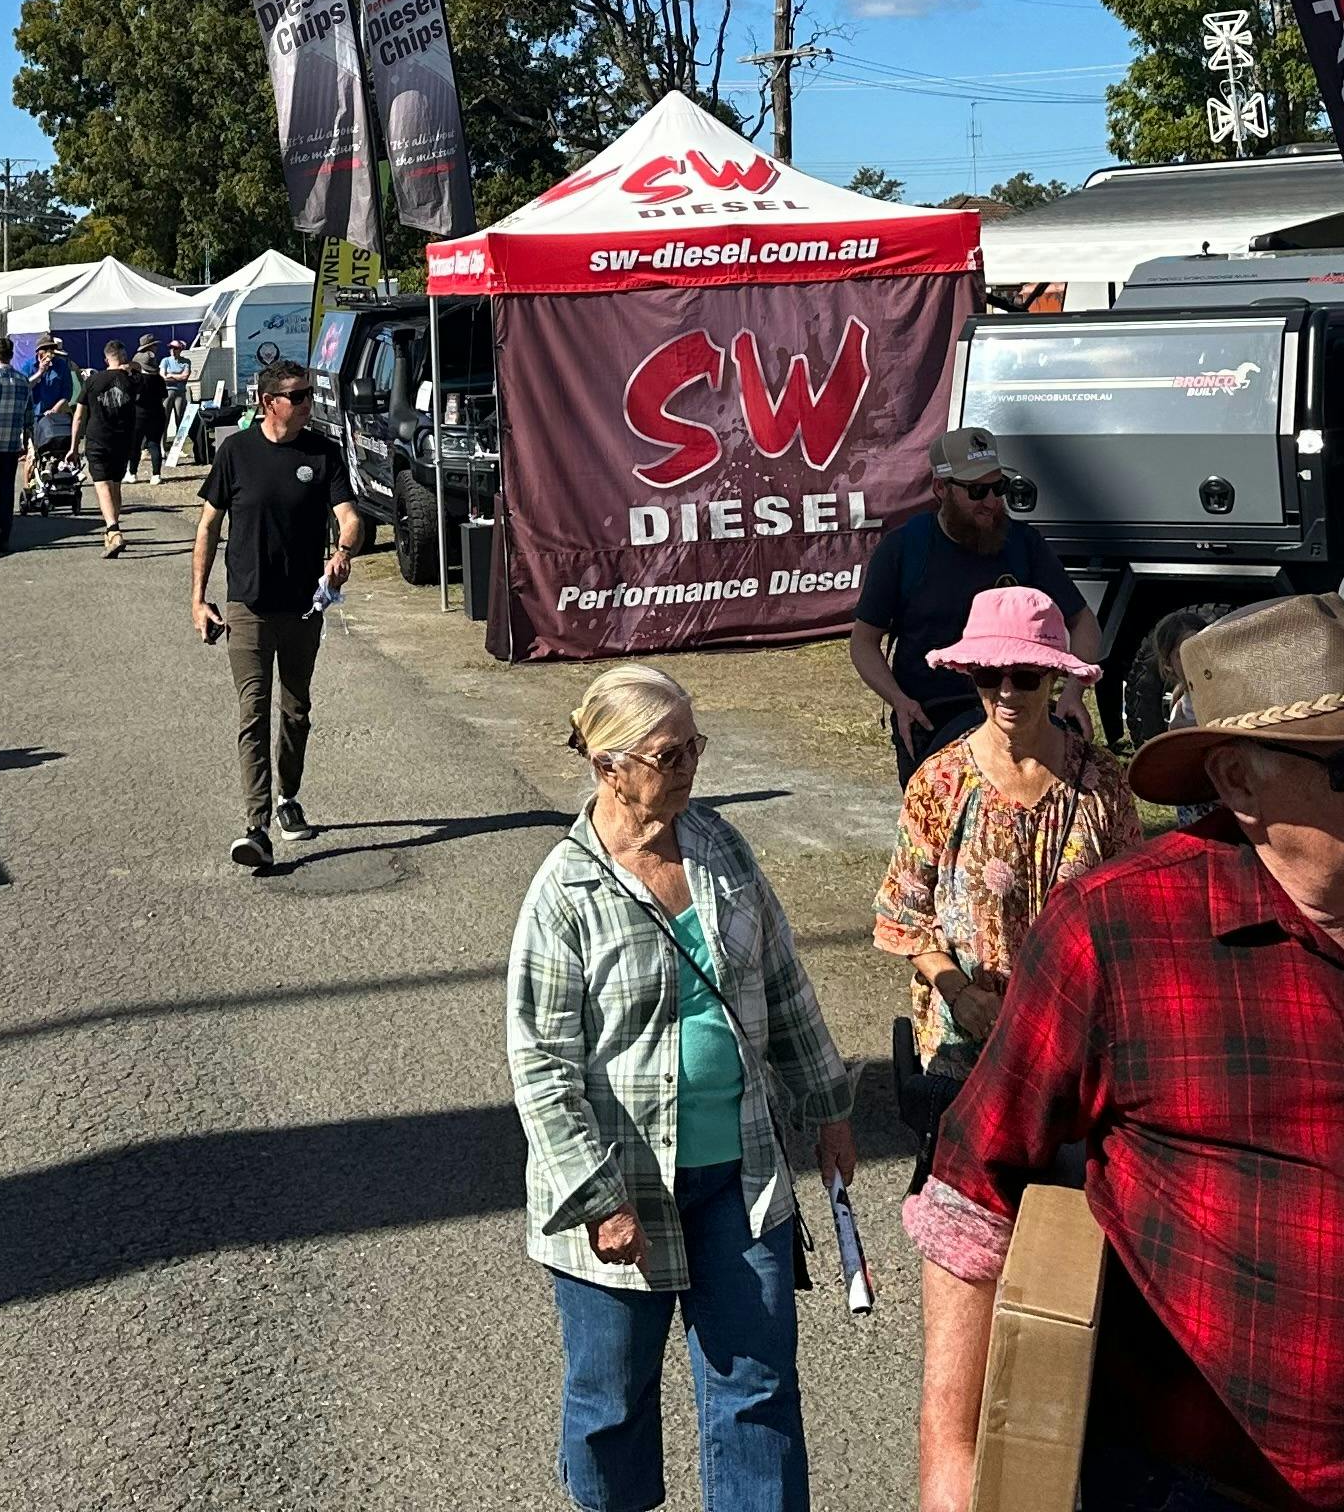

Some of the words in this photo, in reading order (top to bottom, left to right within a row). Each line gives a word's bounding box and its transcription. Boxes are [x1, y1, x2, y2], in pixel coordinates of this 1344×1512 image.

[277, 0, 347, 57] Chips
[381, 16, 444, 67] Chips
[290, 151, 310, 165] the
[395, 153, 415, 167] the
[620, 149, 781, 204] SW
[638, 199, 809, 219] DIESEL
[590, 236, 878, 273] sw-diesel.com.au
[623, 315, 870, 488] SW
[1173, 375, 1237, 387] BRONCO
[1186, 387, 1220, 397] BUILT
[629, 491, 883, 546] DIESEL
[557, 572, 758, 611] Performance
[768, 564, 861, 597] Diesel
